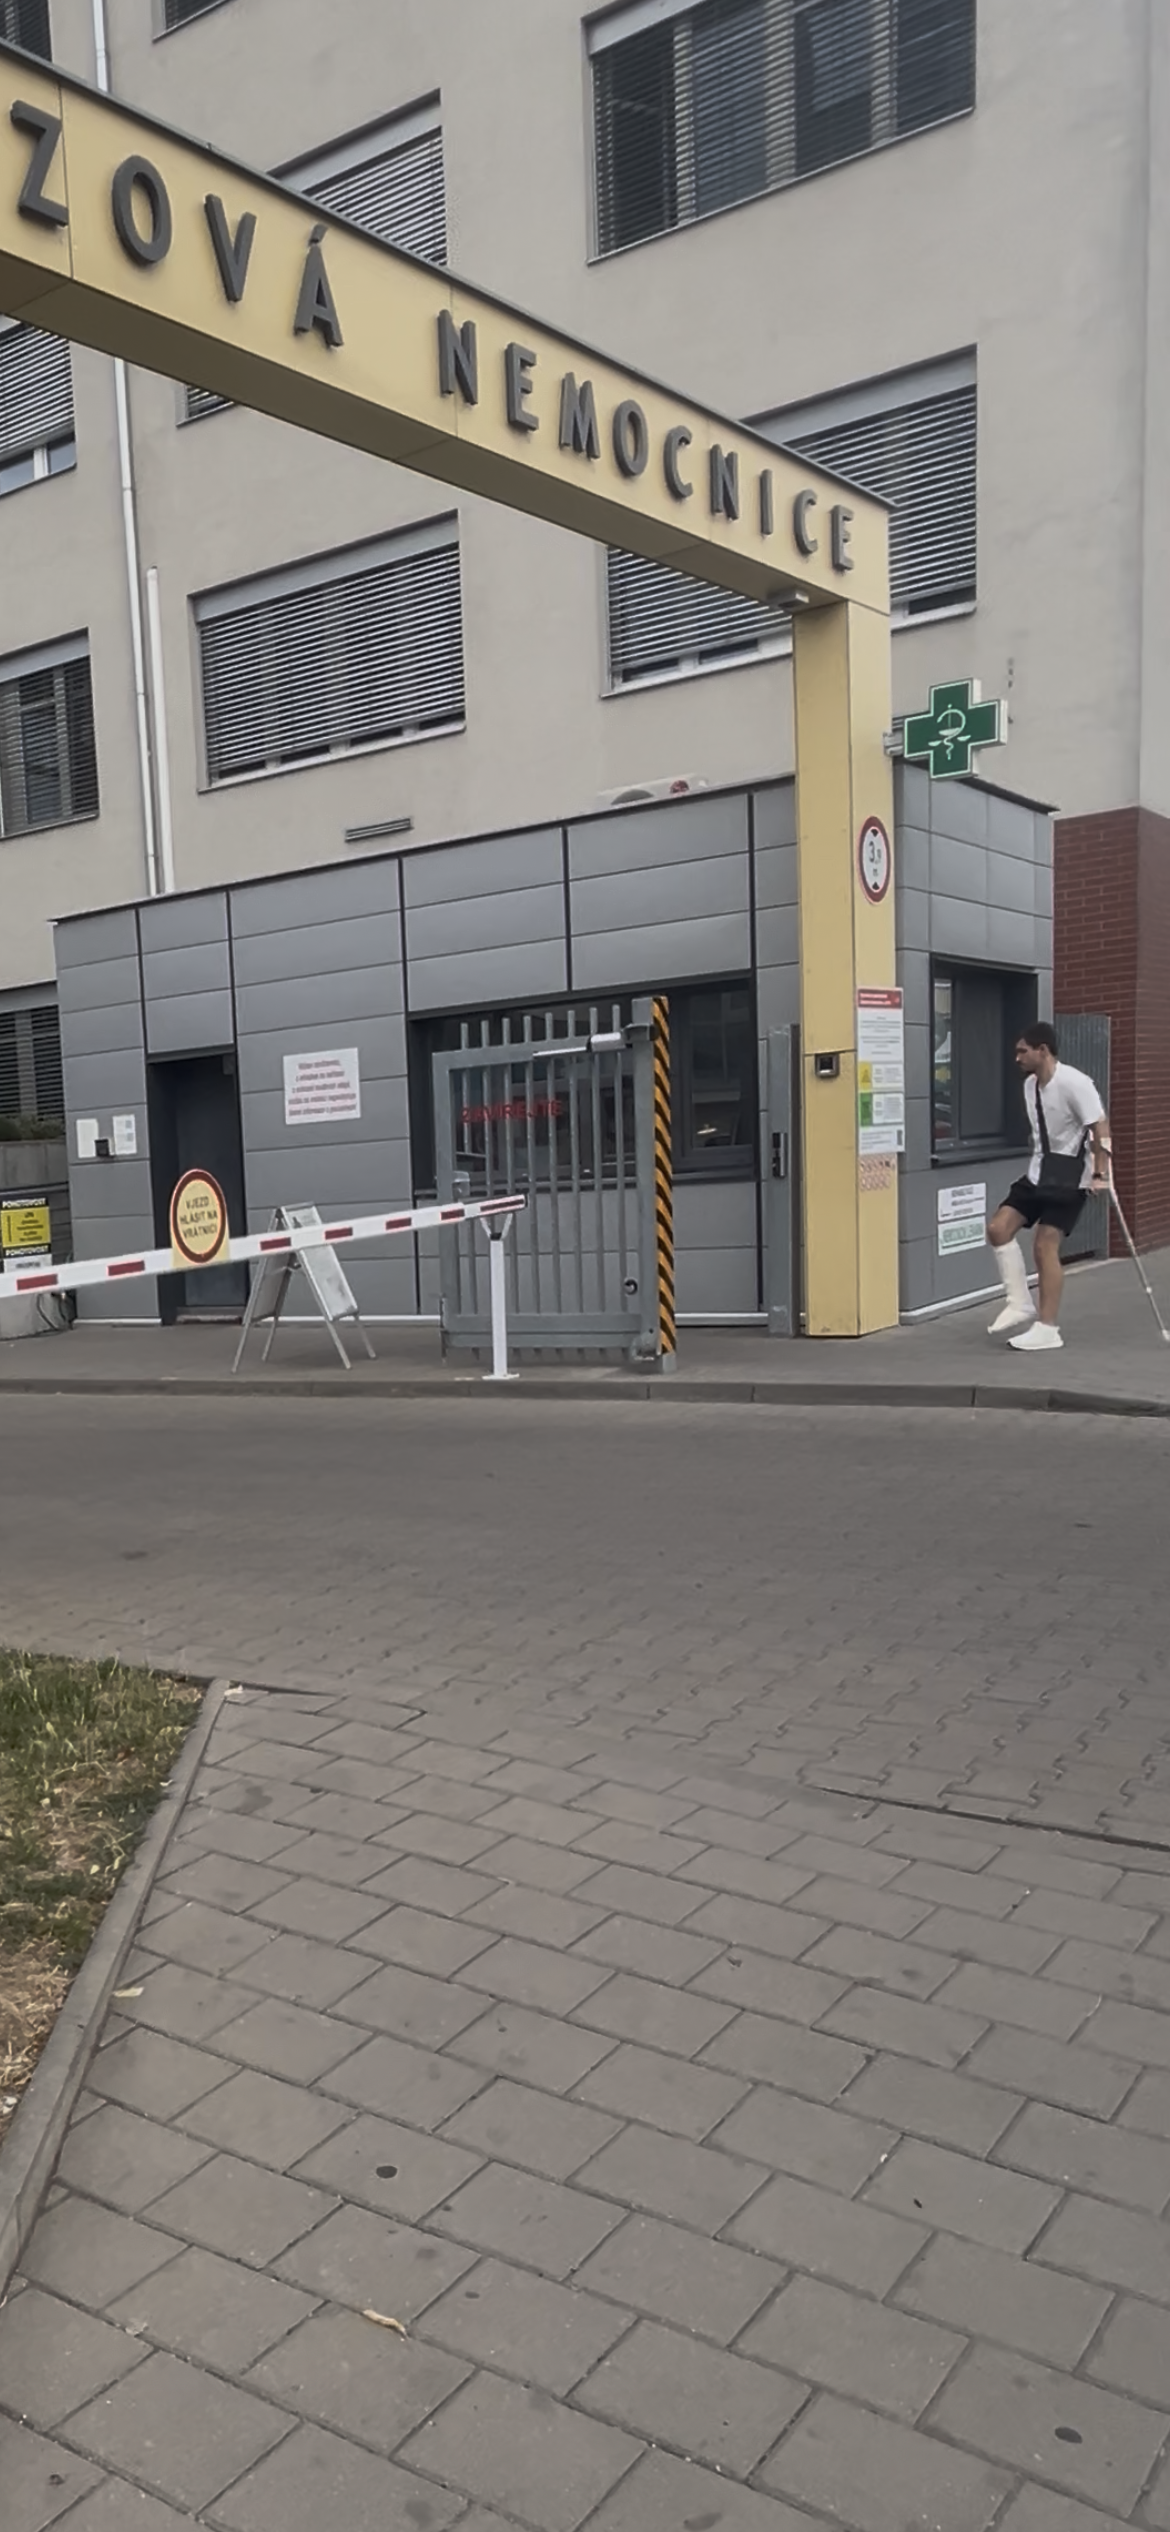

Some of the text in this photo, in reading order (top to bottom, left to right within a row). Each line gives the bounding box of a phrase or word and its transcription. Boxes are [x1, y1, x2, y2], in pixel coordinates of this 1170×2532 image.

[10, 99, 855, 572] ZOVÁ NEMOCNICE
[185, 1195, 209, 1210] VJEZD
